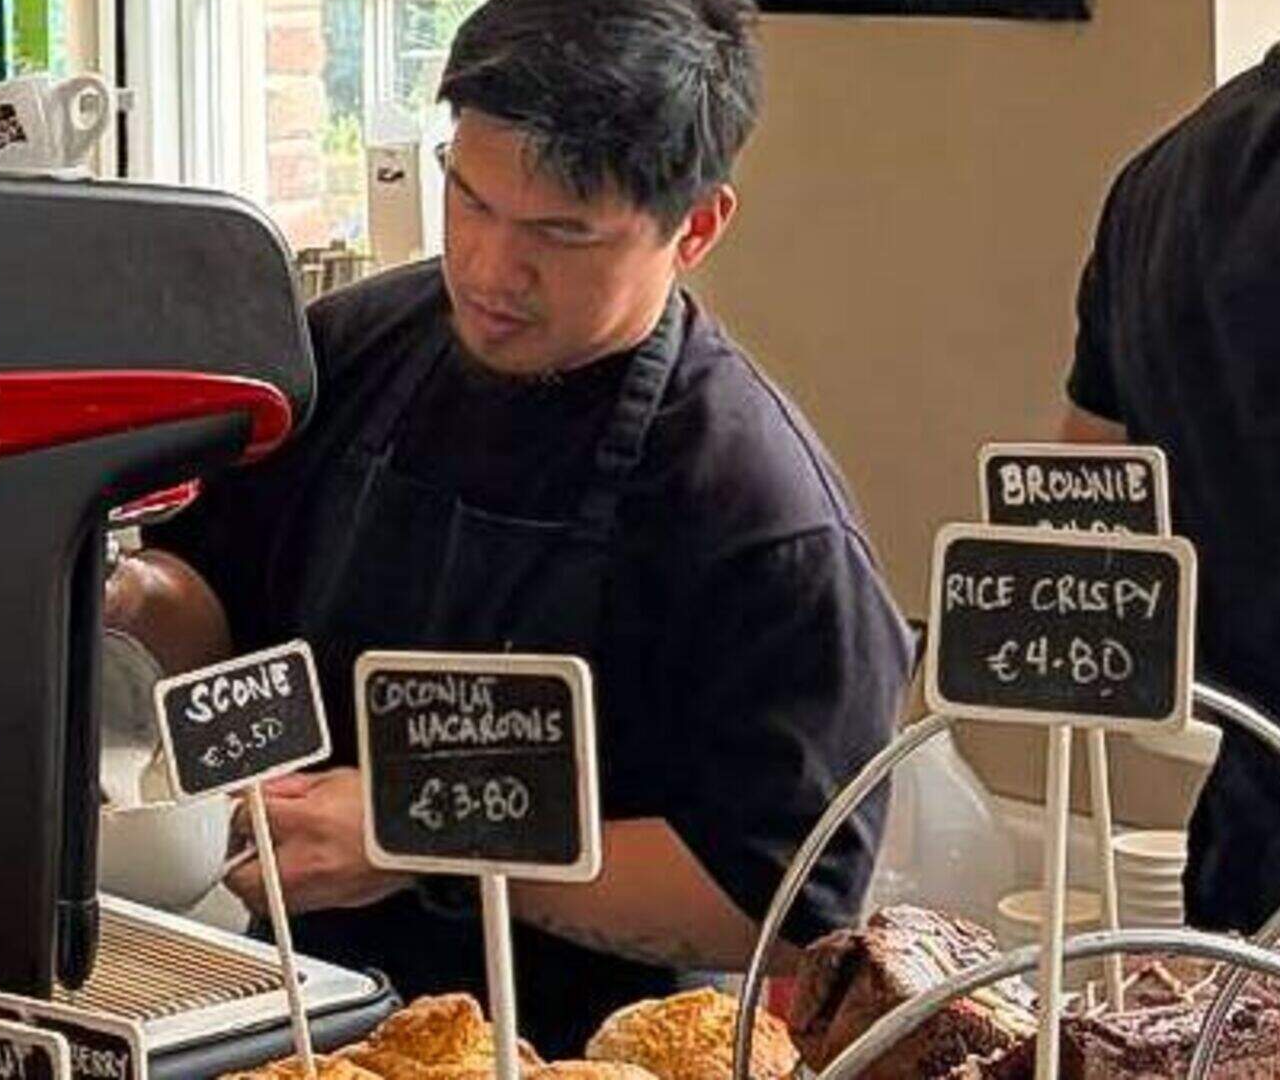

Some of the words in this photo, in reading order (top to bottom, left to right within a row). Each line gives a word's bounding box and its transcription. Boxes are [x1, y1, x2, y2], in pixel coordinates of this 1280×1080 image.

[998, 461, 1148, 506] BROWNIE
[945, 572, 1017, 613] RICE
[1030, 574, 1162, 620] CRISPY
[985, 635, 1133, 684] €4.80
[184, 661, 293, 723] SCONE
[371, 675, 498, 715] COCONUT
[407, 708, 564, 749] MACAROONS
